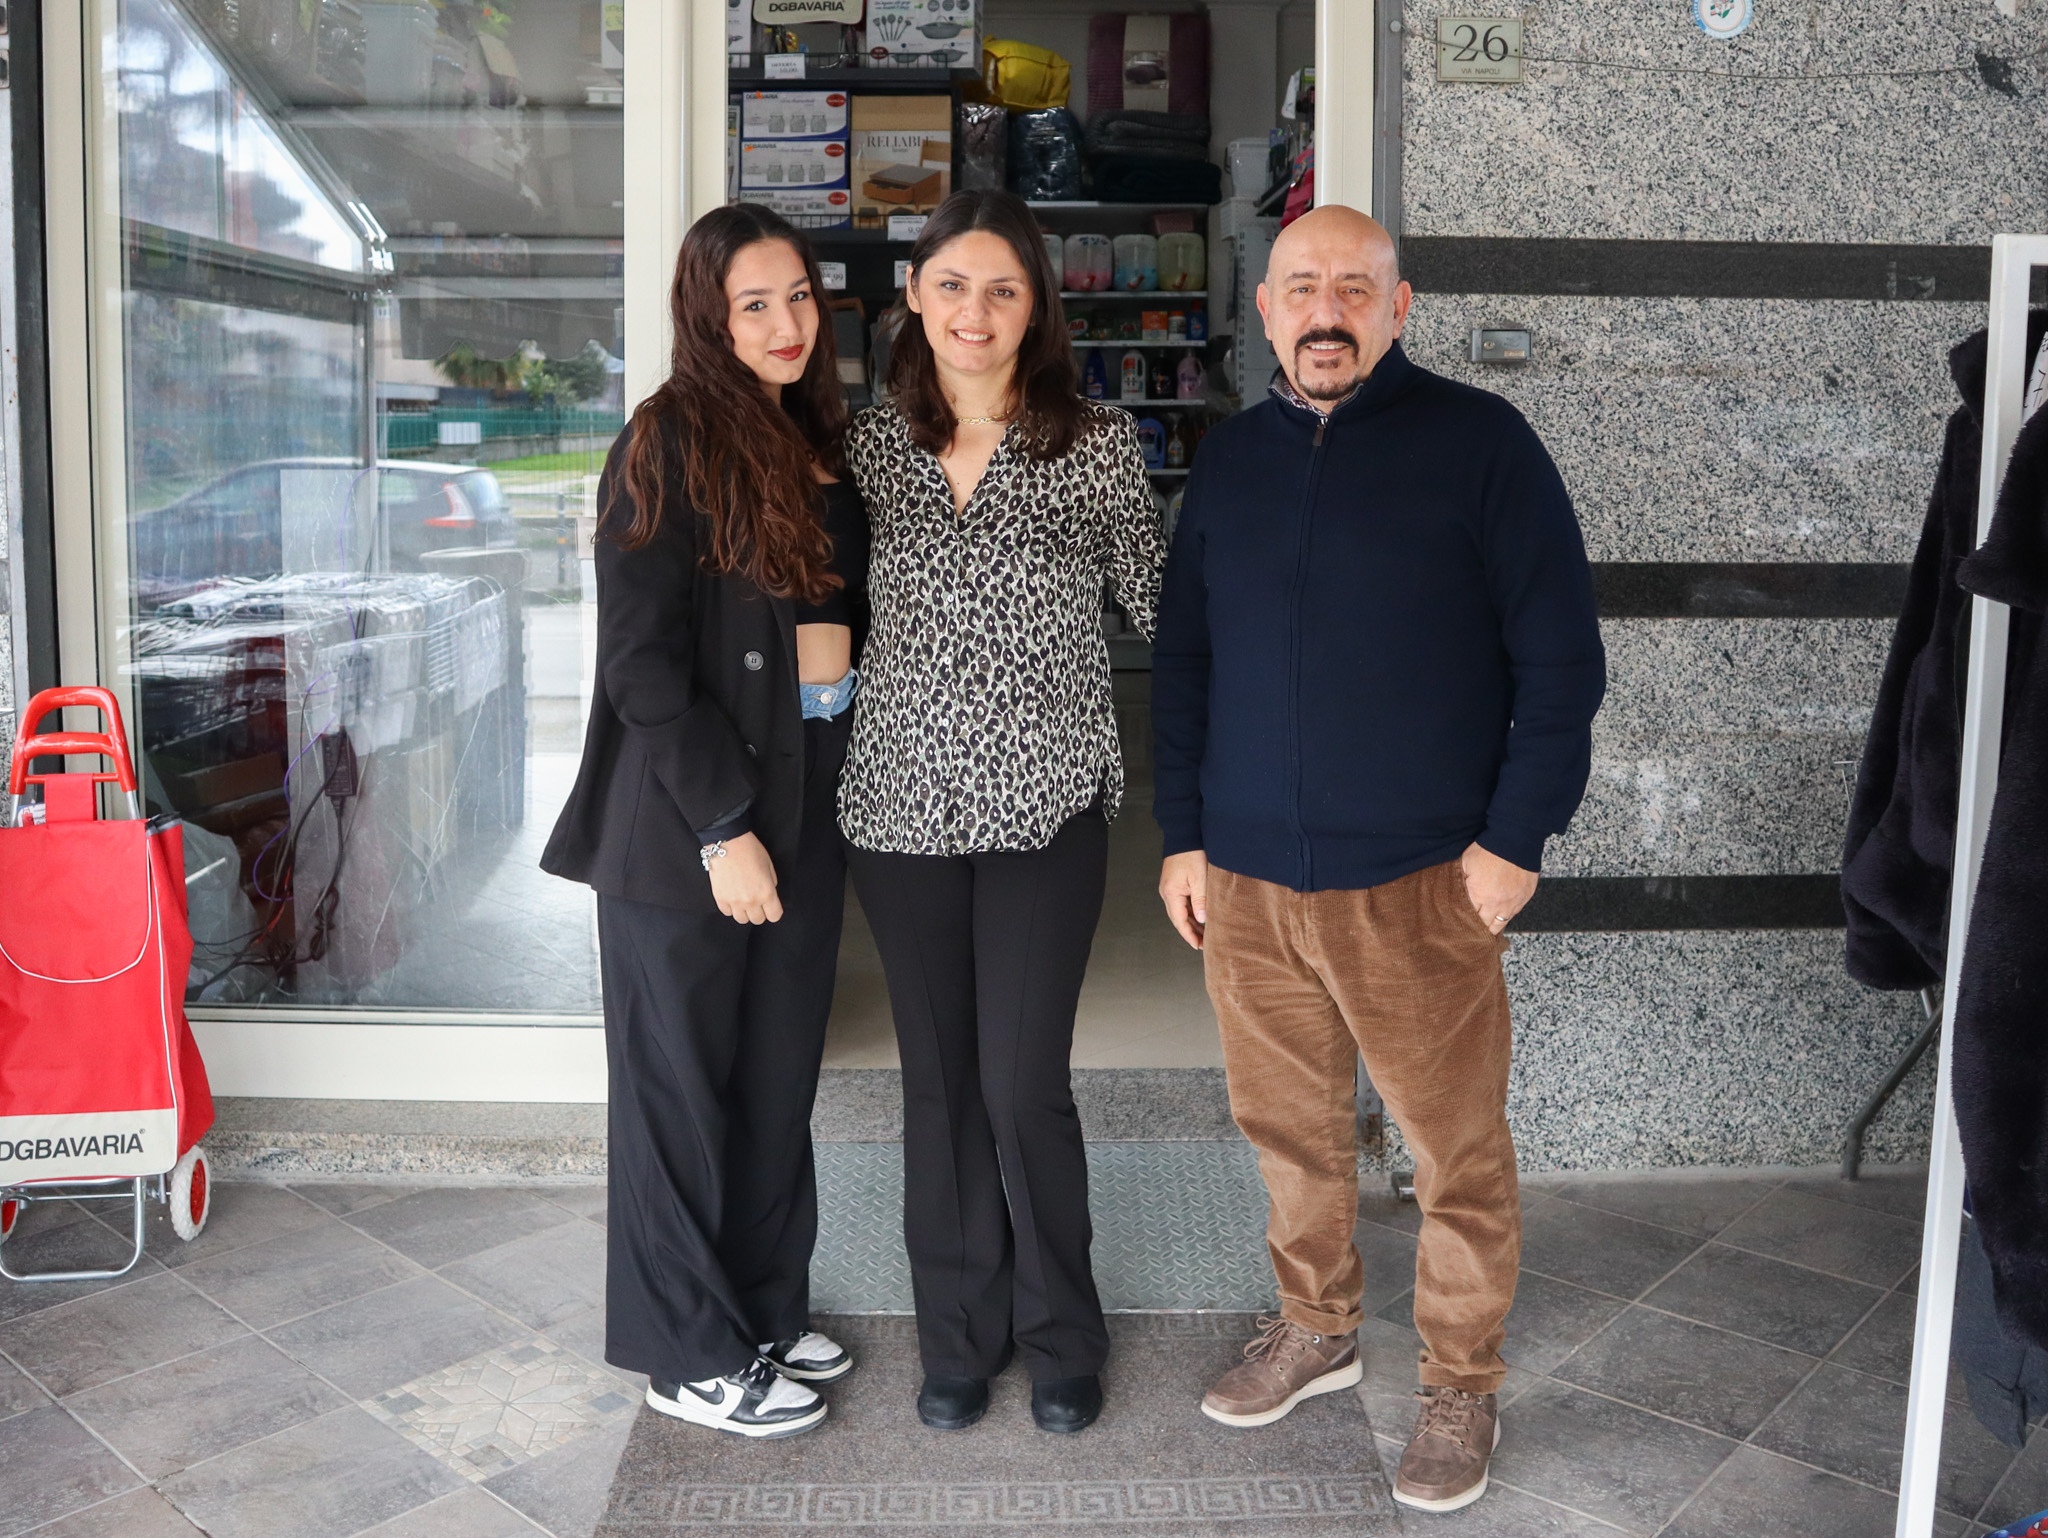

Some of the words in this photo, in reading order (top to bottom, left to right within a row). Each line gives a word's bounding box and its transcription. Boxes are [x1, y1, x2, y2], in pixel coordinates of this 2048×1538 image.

[769, 1, 844, 12] DGBAVARIA
[1452, 24, 1509, 62] 26
[0, 1133, 144, 1161] DGBAVARIA
